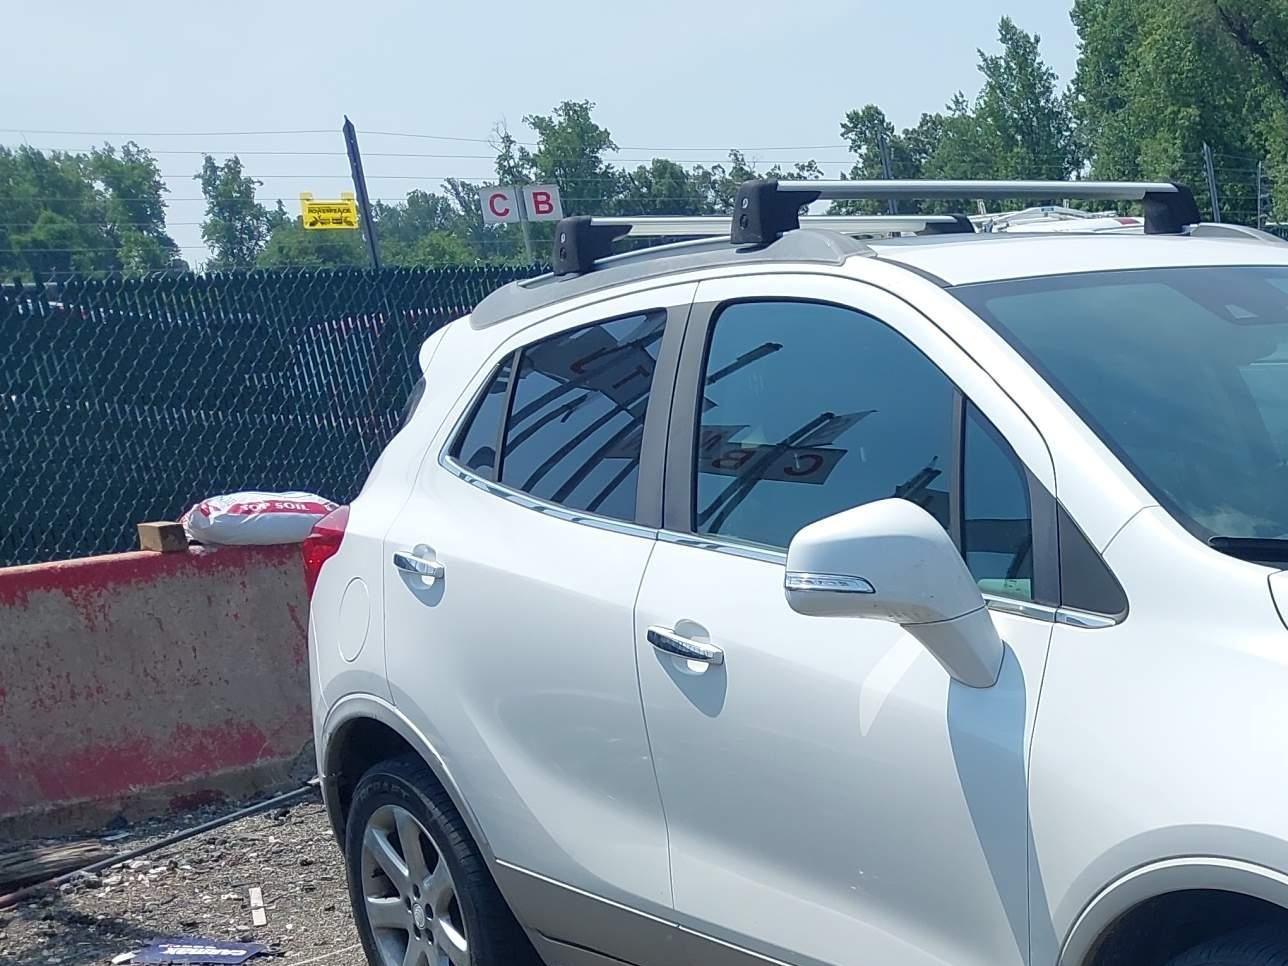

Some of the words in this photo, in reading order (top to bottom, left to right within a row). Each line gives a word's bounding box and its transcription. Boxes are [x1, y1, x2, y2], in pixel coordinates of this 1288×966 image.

[489, 192, 510, 217] C
[533, 191, 554, 216] B
[240, 501, 271, 514] TOP
[276, 501, 312, 511] SOIL
